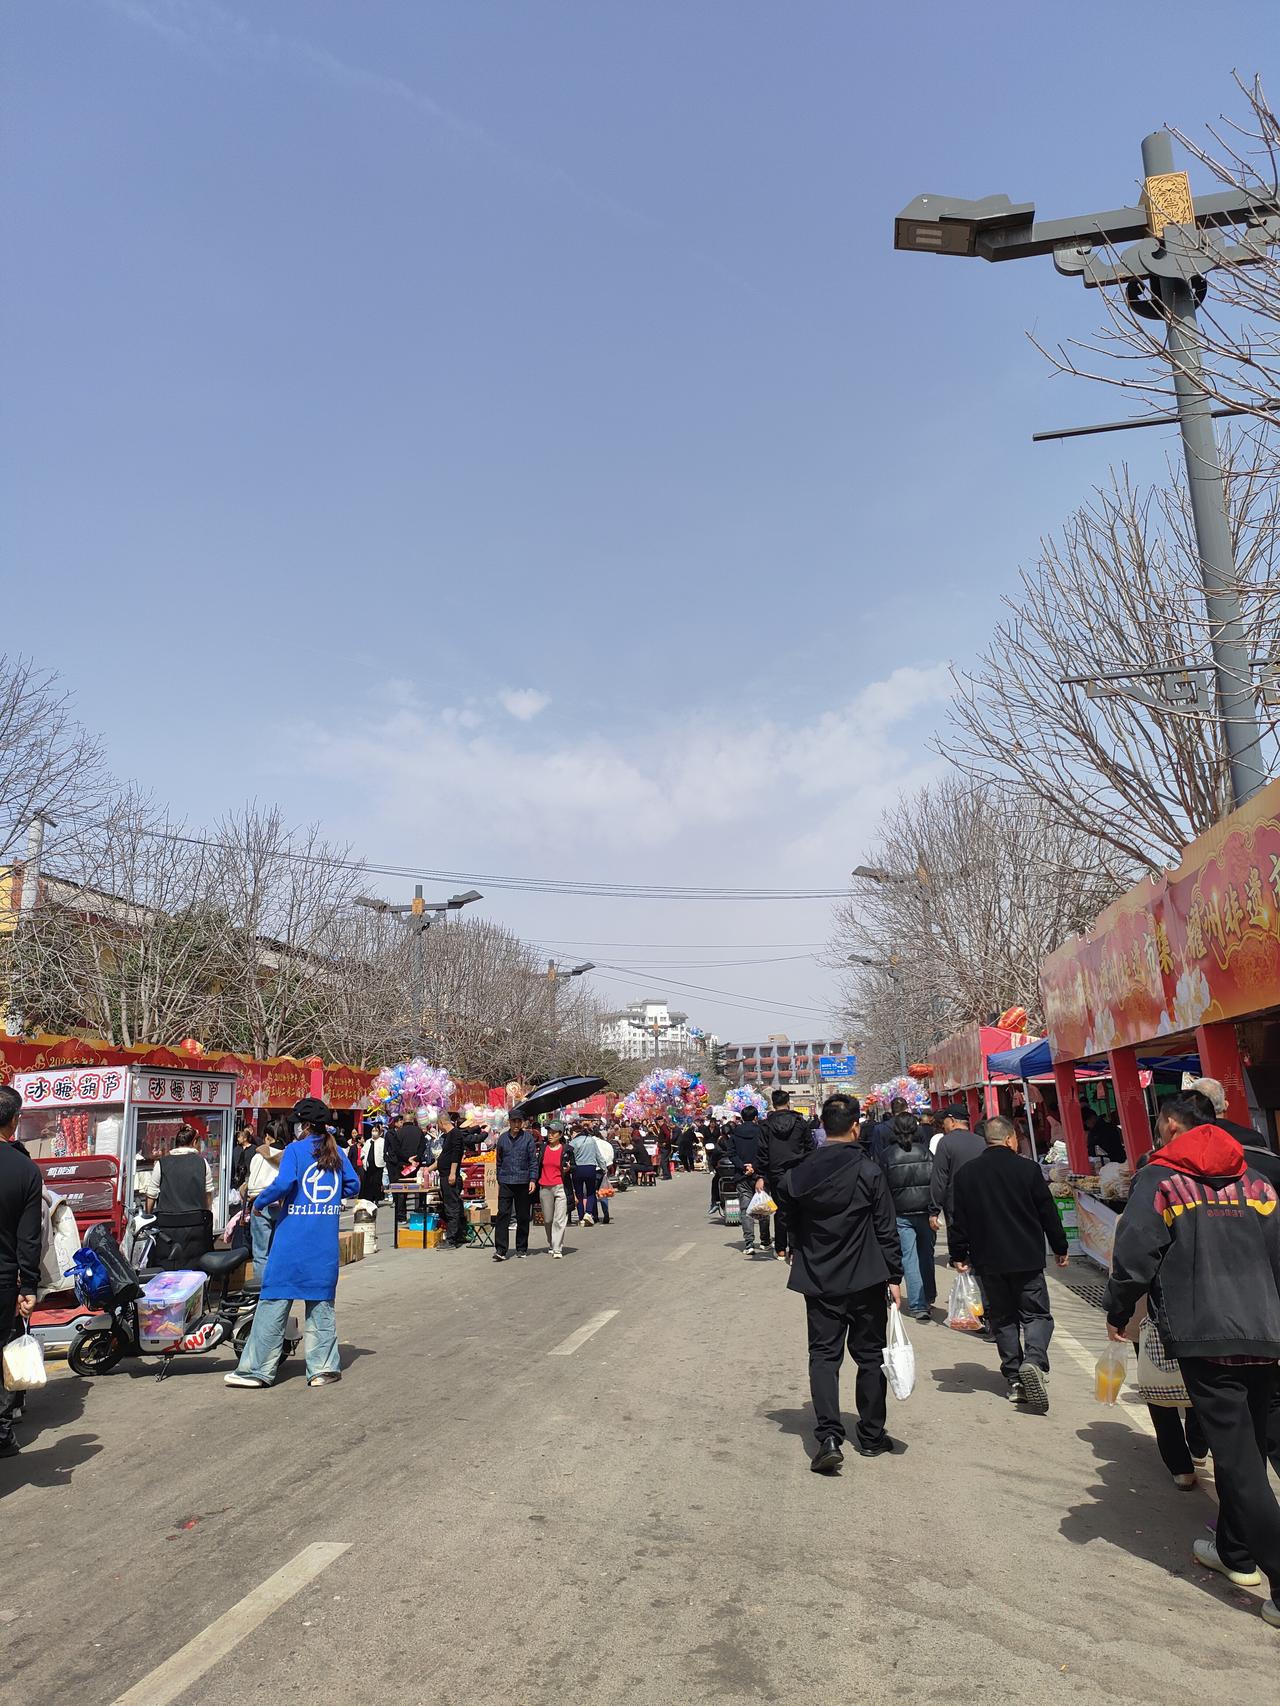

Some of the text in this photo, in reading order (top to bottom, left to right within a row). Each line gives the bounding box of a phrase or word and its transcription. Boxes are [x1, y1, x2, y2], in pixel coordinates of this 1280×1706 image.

[26, 1071, 122, 1102] 冰糖葫芦
[149, 1077, 219, 1102] 冰糖葫芦
